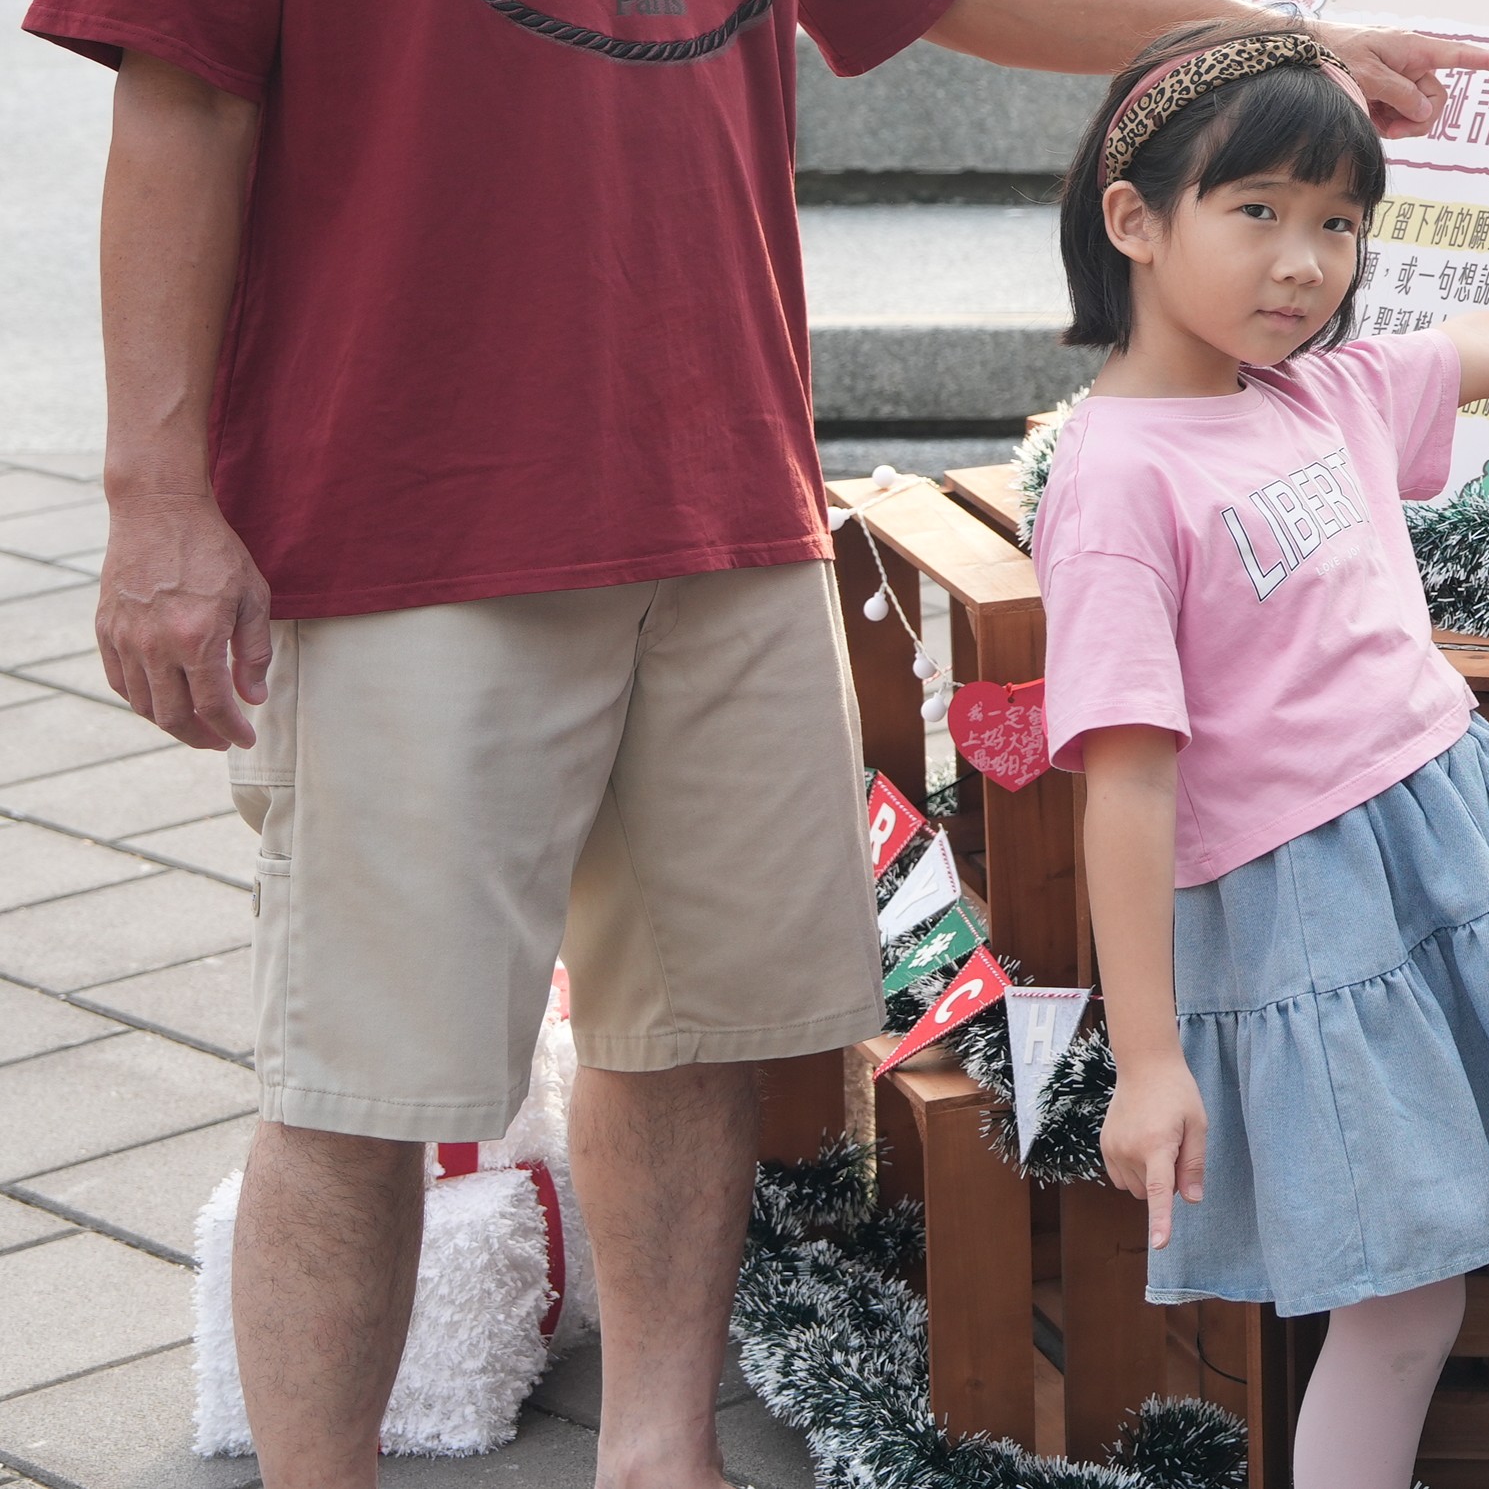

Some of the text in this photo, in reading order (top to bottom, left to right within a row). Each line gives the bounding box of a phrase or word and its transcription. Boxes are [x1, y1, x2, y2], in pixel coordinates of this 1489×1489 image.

[1315, 555, 1341, 576] LOVE
[934, 978, 1058, 1066] C H
